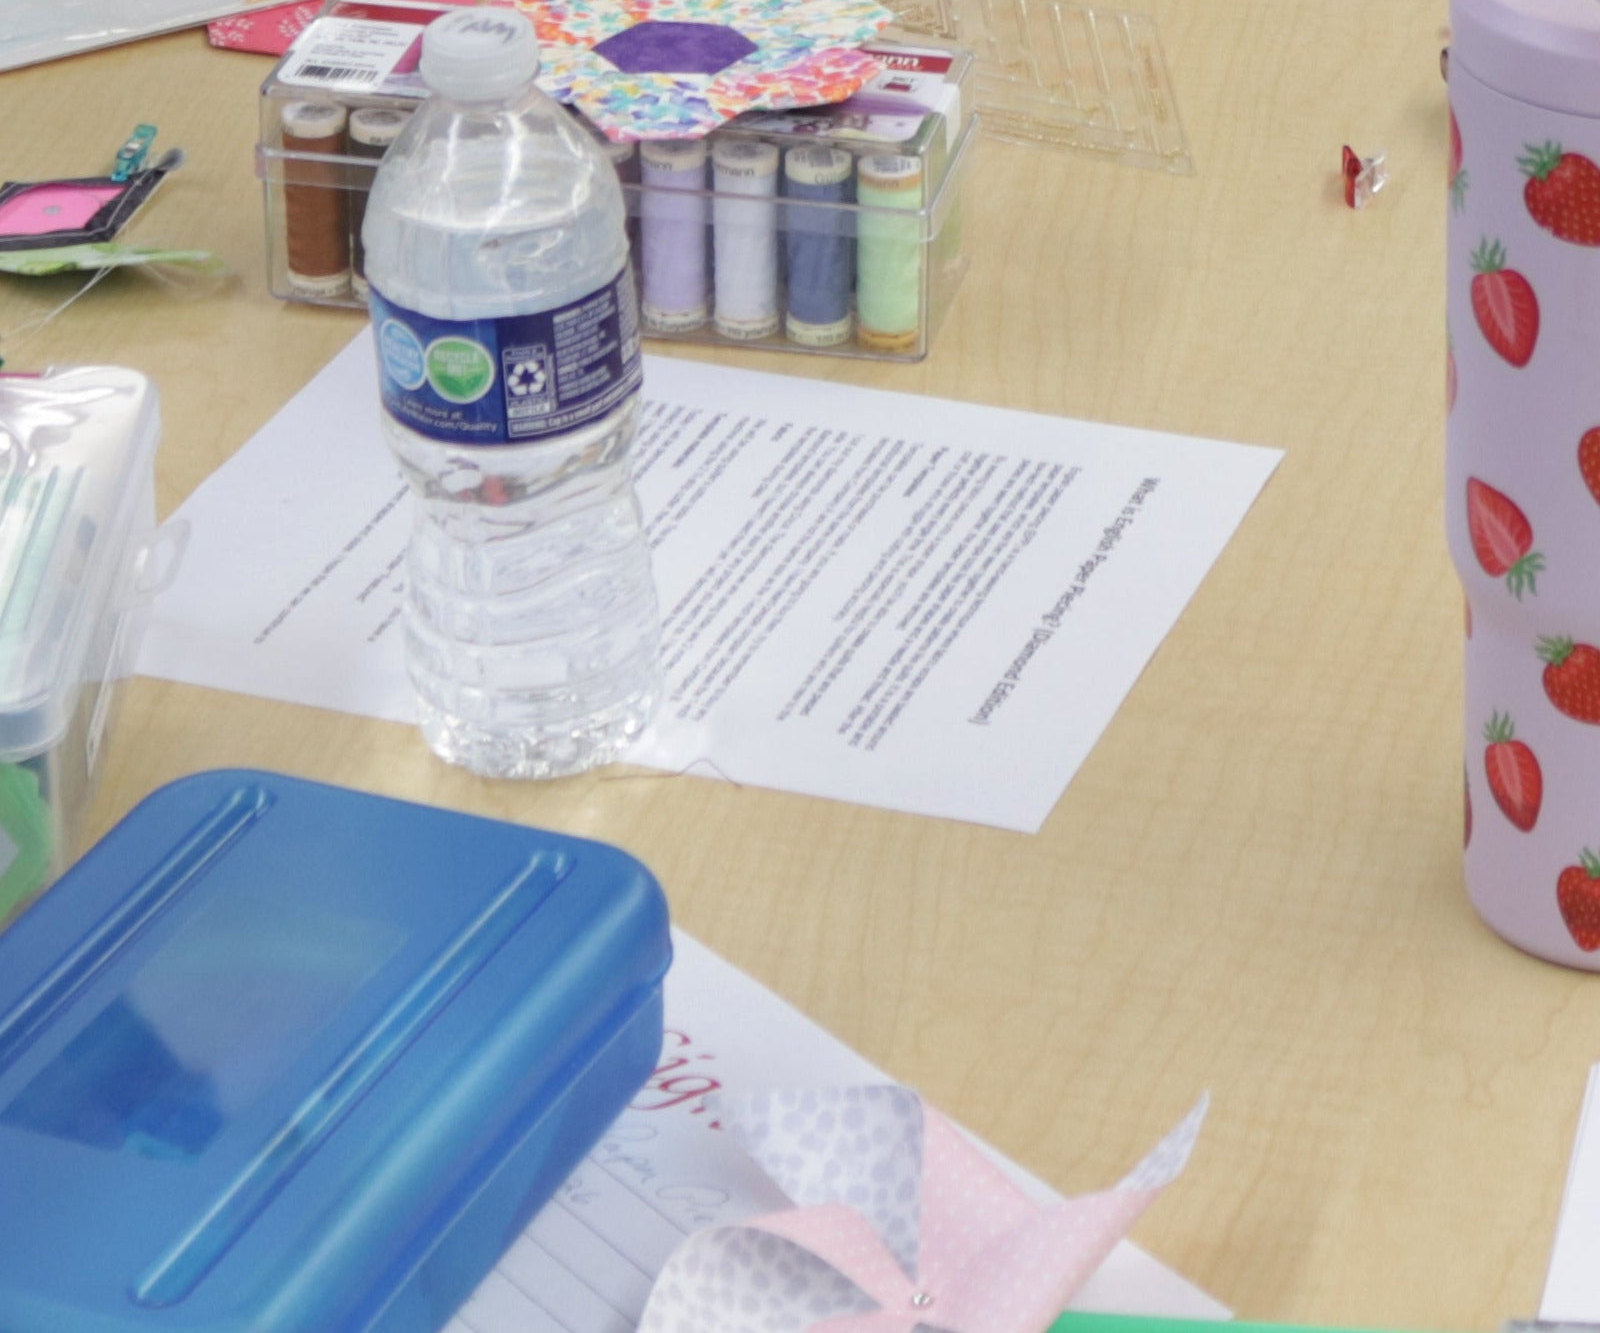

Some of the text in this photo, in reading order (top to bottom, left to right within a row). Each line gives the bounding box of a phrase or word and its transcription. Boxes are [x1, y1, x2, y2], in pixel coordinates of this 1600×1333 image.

[1129, 477, 1161, 506] What
[1096, 516, 1134, 552] English
[1074, 553, 1108, 585] Paper
[1041, 584, 1086, 628] Piecing?
[967, 680, 1016, 726] Edition)
